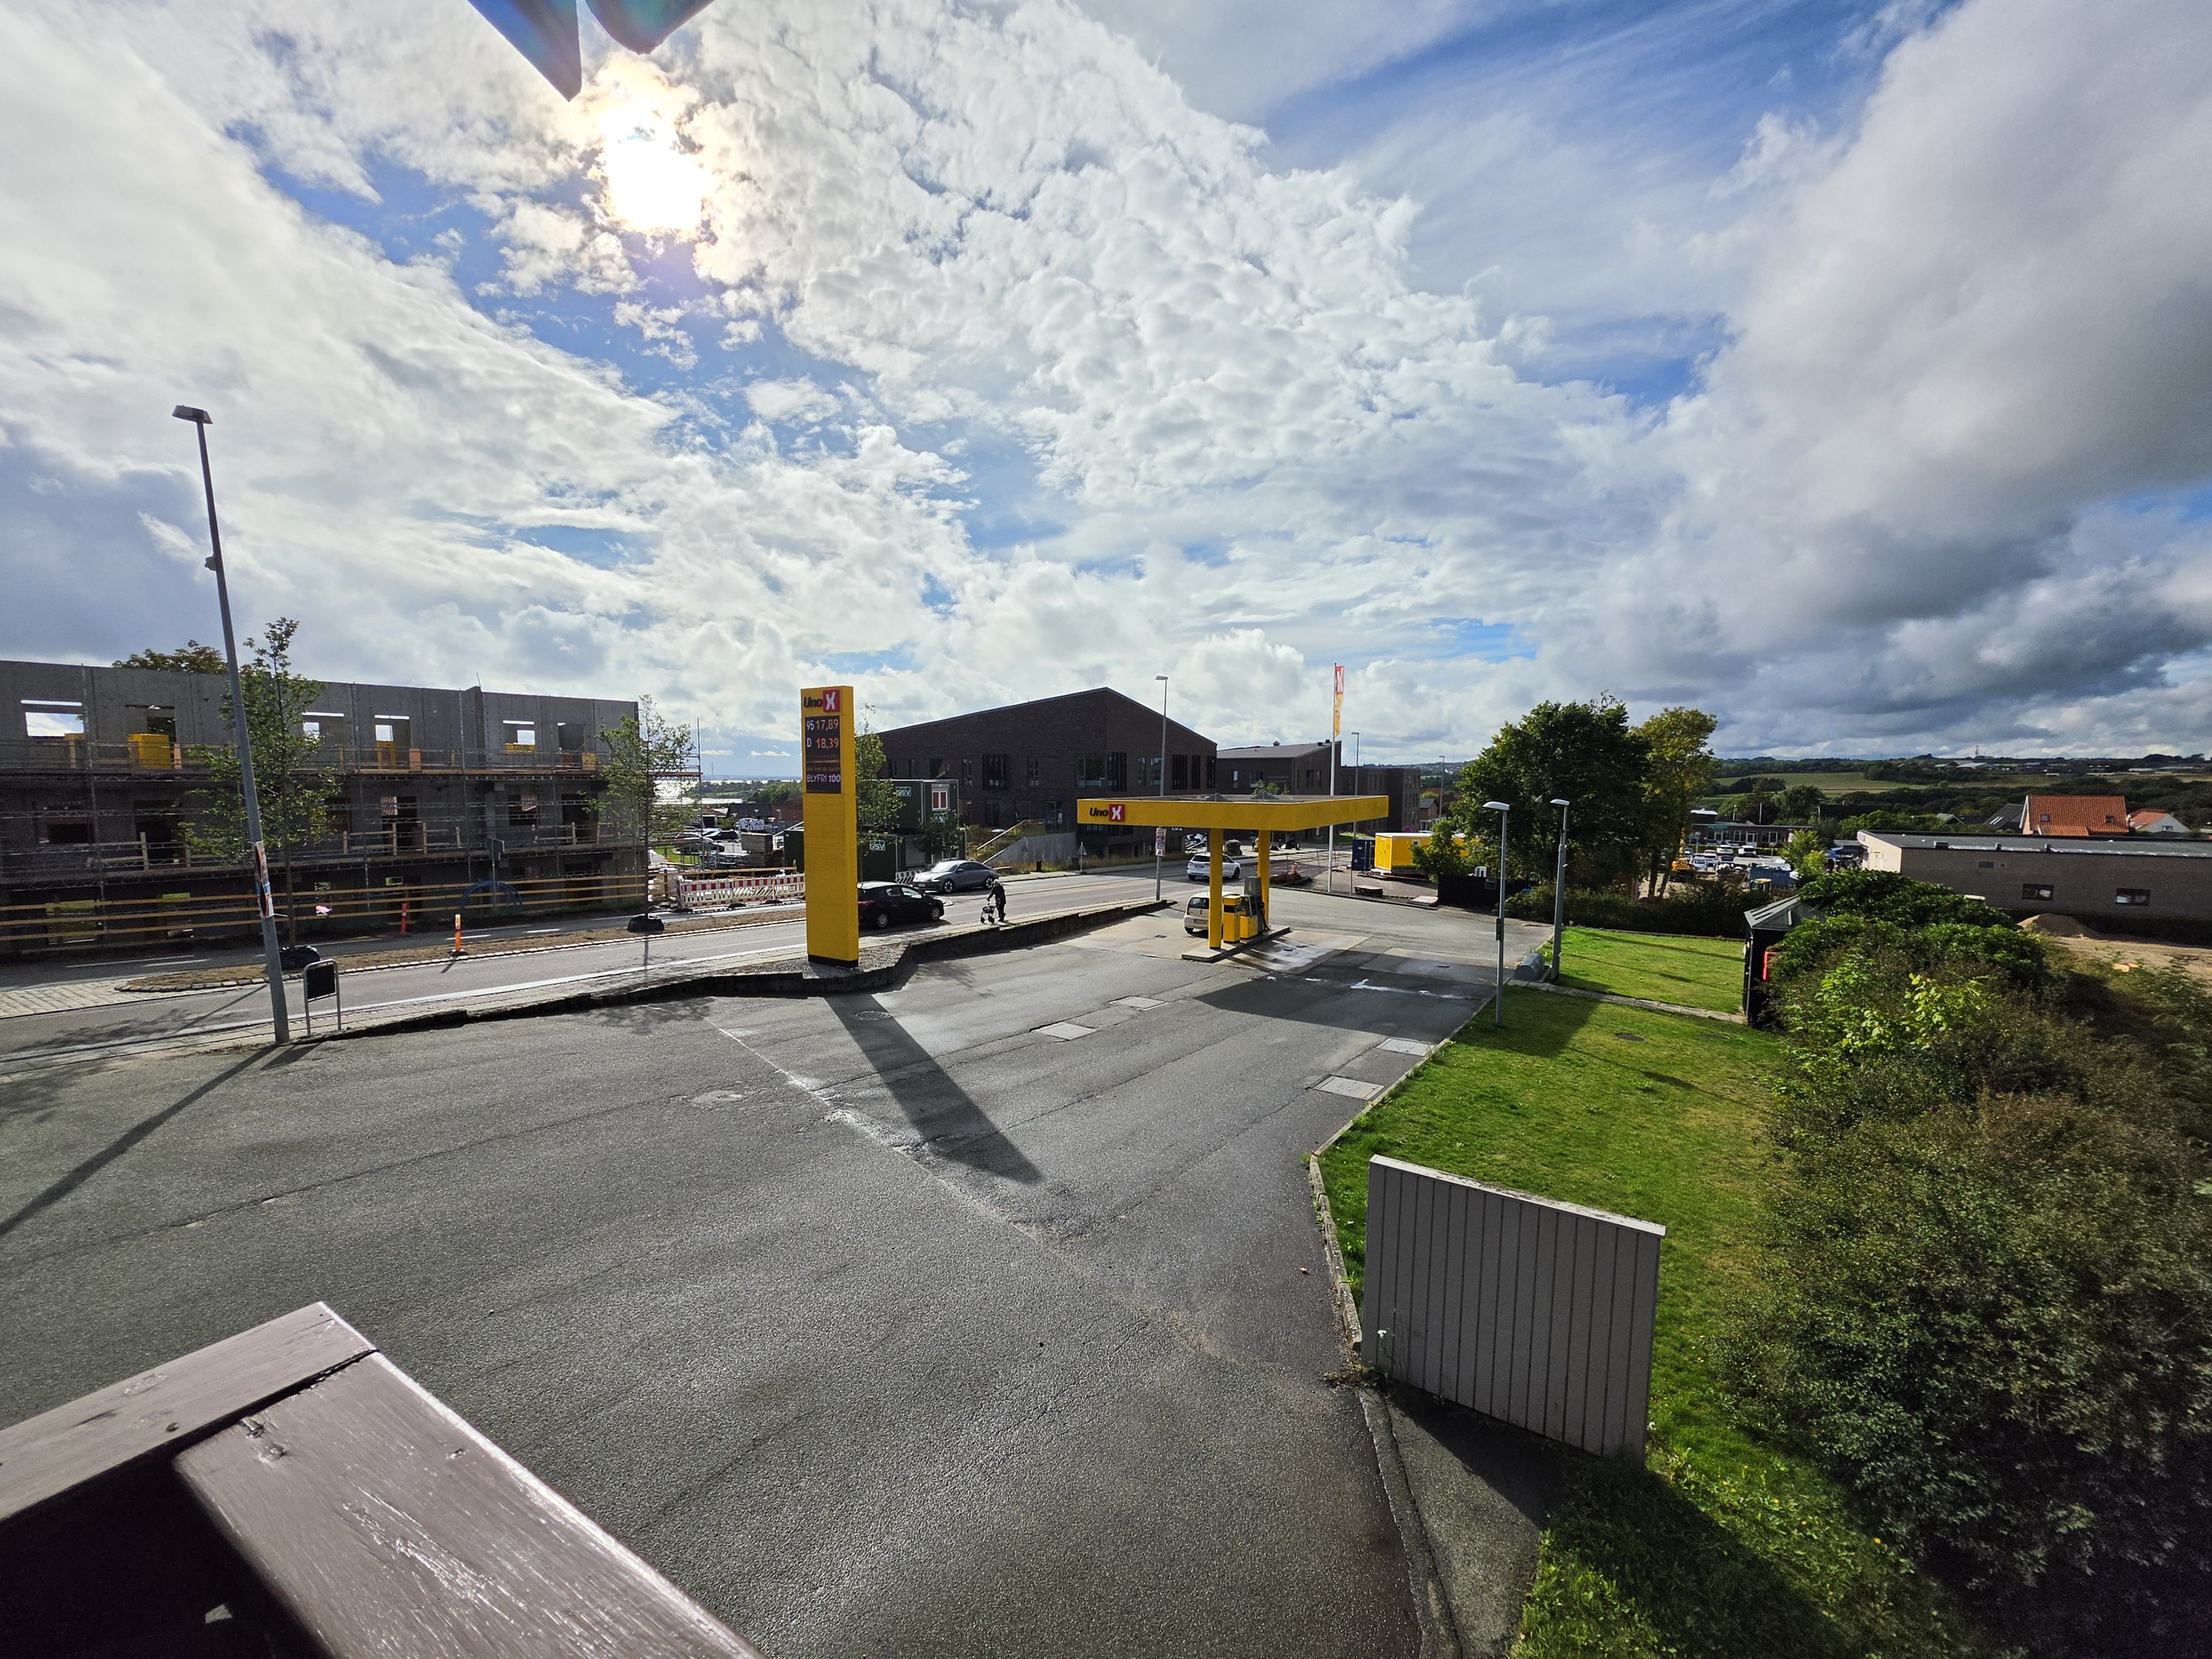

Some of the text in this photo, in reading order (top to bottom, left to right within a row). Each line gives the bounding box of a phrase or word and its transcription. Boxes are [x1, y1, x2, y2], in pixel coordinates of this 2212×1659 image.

[804, 691, 836, 710] Uno X
[806, 719, 838, 732] 95 17,89
[807, 738, 839, 750] D 18,39
[807, 774, 841, 782] BLYFRI 100
[1089, 805, 1122, 820] Uno X
